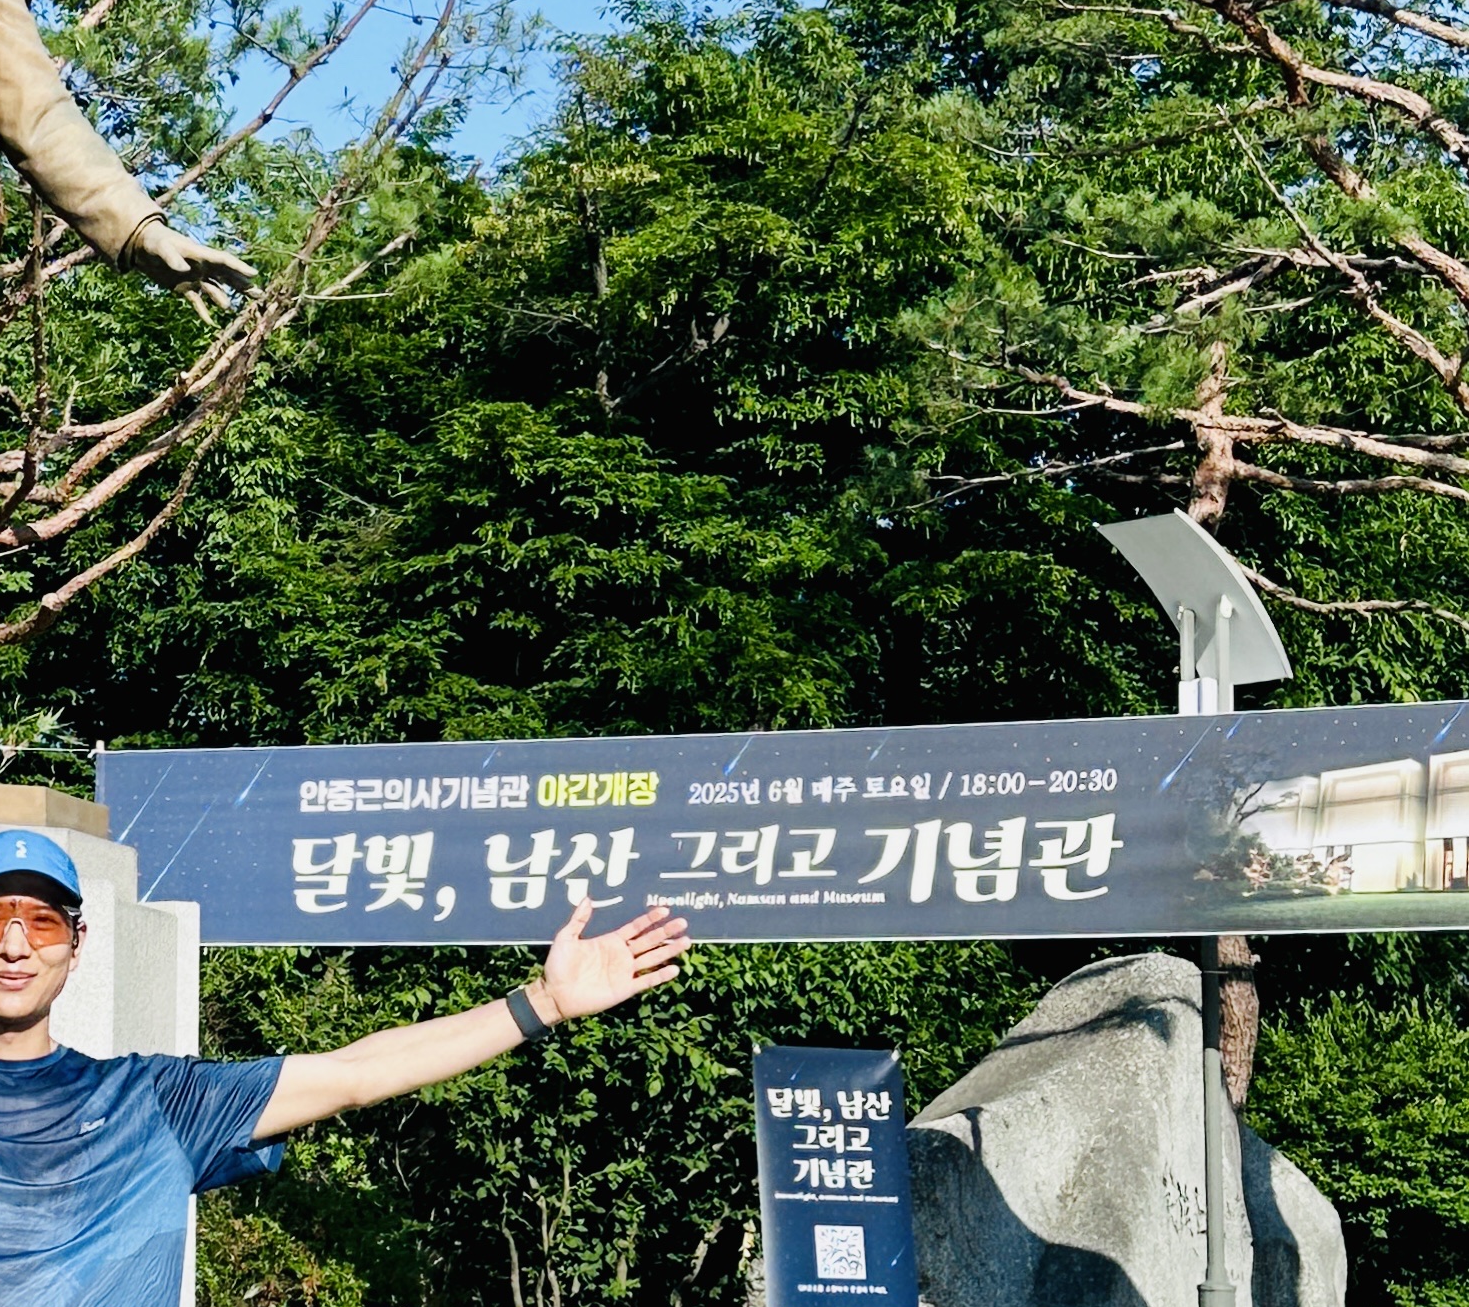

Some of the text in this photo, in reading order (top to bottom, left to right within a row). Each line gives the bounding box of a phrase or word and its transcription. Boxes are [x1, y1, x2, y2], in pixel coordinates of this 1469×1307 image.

[299, 775, 529, 812] 안중근의사기념관
[537, 772, 660, 808] 야간개장
[688, 778, 760, 804] 2025년
[769, 777, 803, 804] 6월
[811, 776, 857, 803] 매주
[862, 772, 931, 800] 토요일
[292, 813, 1124, 922] 달빛, 남산 그리고 기념관
[790, 891, 819, 905] and
[767, 1088, 893, 1122] 달빛, 남산
[792, 1124, 873, 1154] 그리고
[793, 1157, 876, 1189] 기념관
